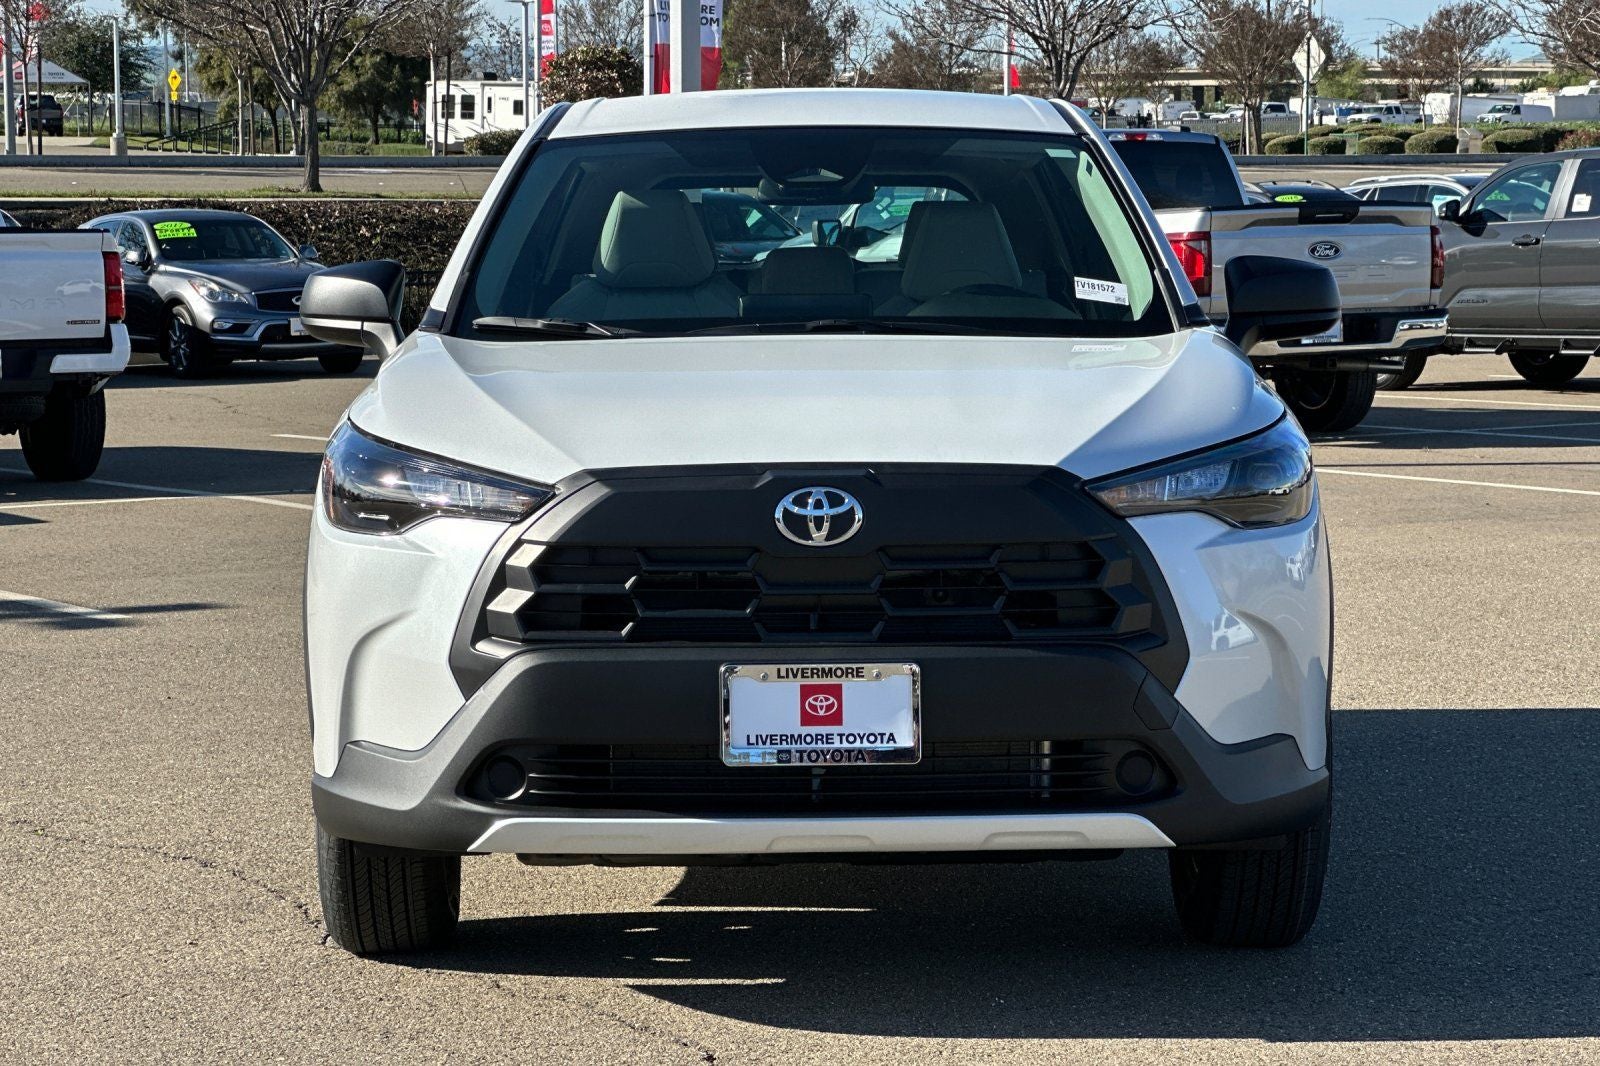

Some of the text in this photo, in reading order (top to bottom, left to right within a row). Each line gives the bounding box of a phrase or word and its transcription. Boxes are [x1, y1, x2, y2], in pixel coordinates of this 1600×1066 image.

[1314, 245, 1336, 256] Ford
[1076, 280, 1116, 293] TV181572
[776, 666, 865, 680] LIVERMORE
[746, 732, 898, 746] LIVERMORE TOYOTA
[796, 749, 867, 763] TOYOTA
